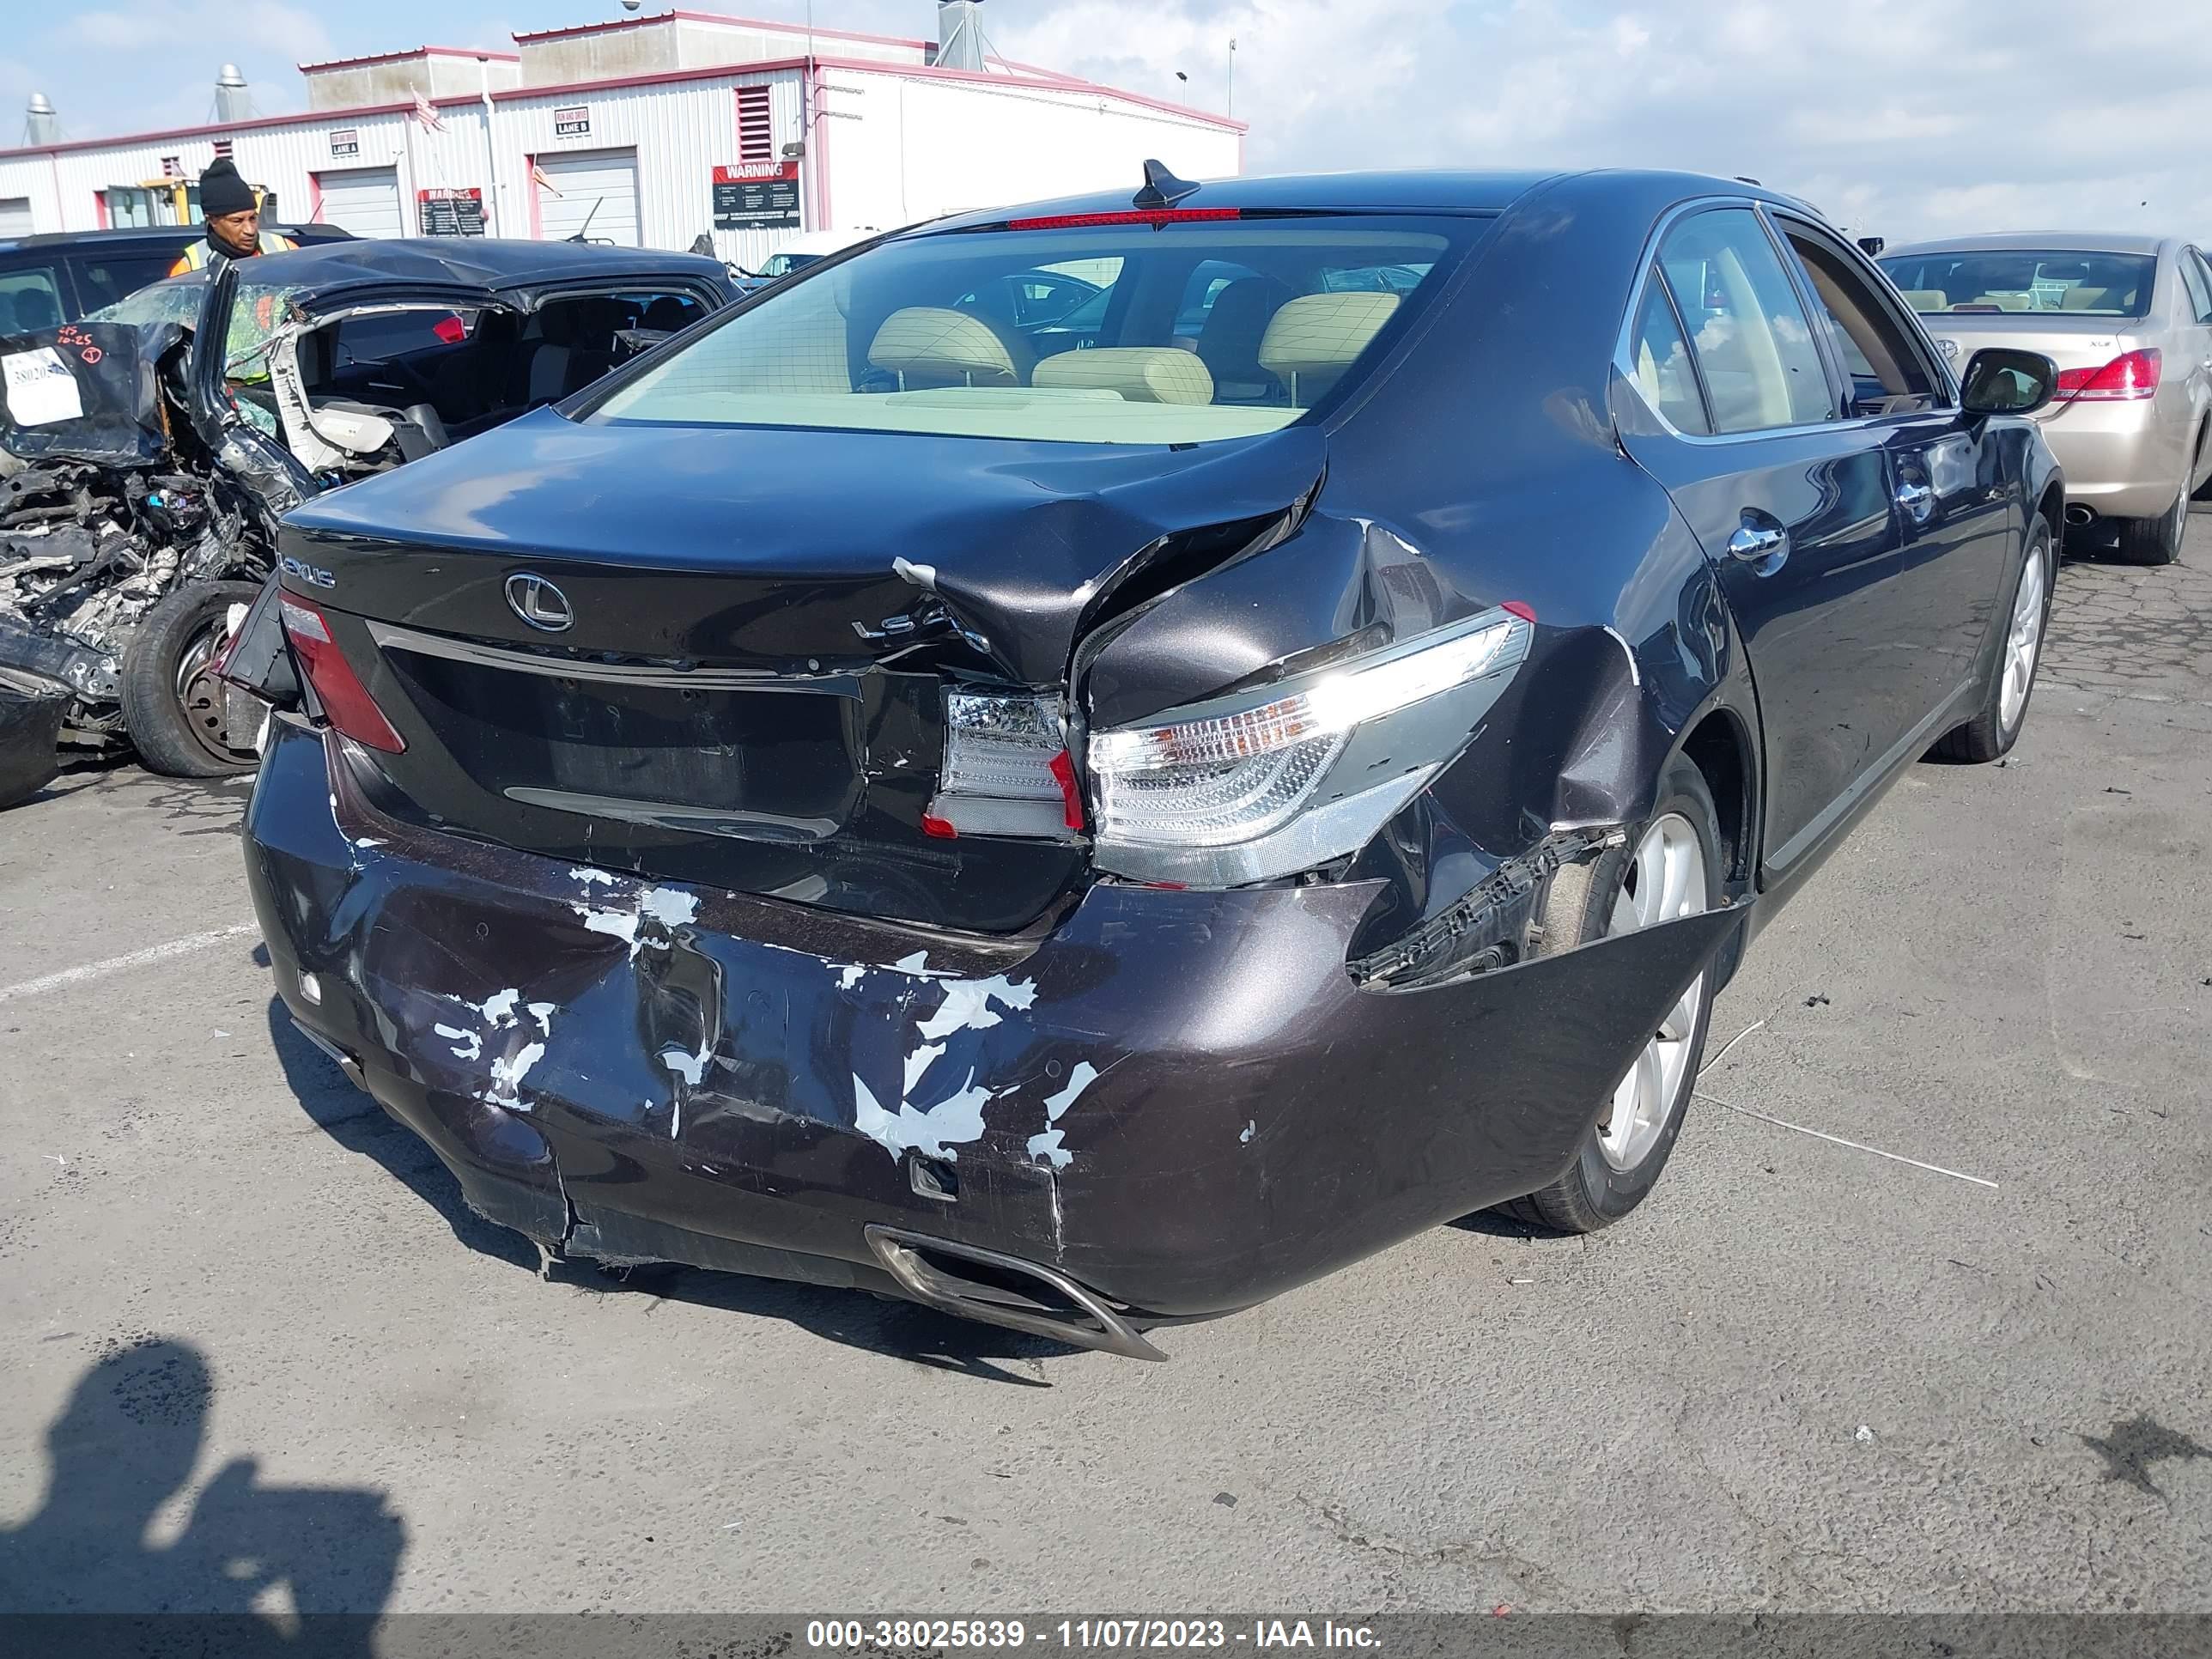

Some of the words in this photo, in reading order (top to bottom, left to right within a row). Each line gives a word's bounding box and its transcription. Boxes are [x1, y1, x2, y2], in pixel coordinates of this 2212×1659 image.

[558, 123, 580, 133] LANE
[580, 122, 587, 131] B
[333, 144, 350, 154] LANE
[351, 143, 356, 152] A
[726, 163, 783, 179] WARNING
[58, 334, 93, 345] 10-25
